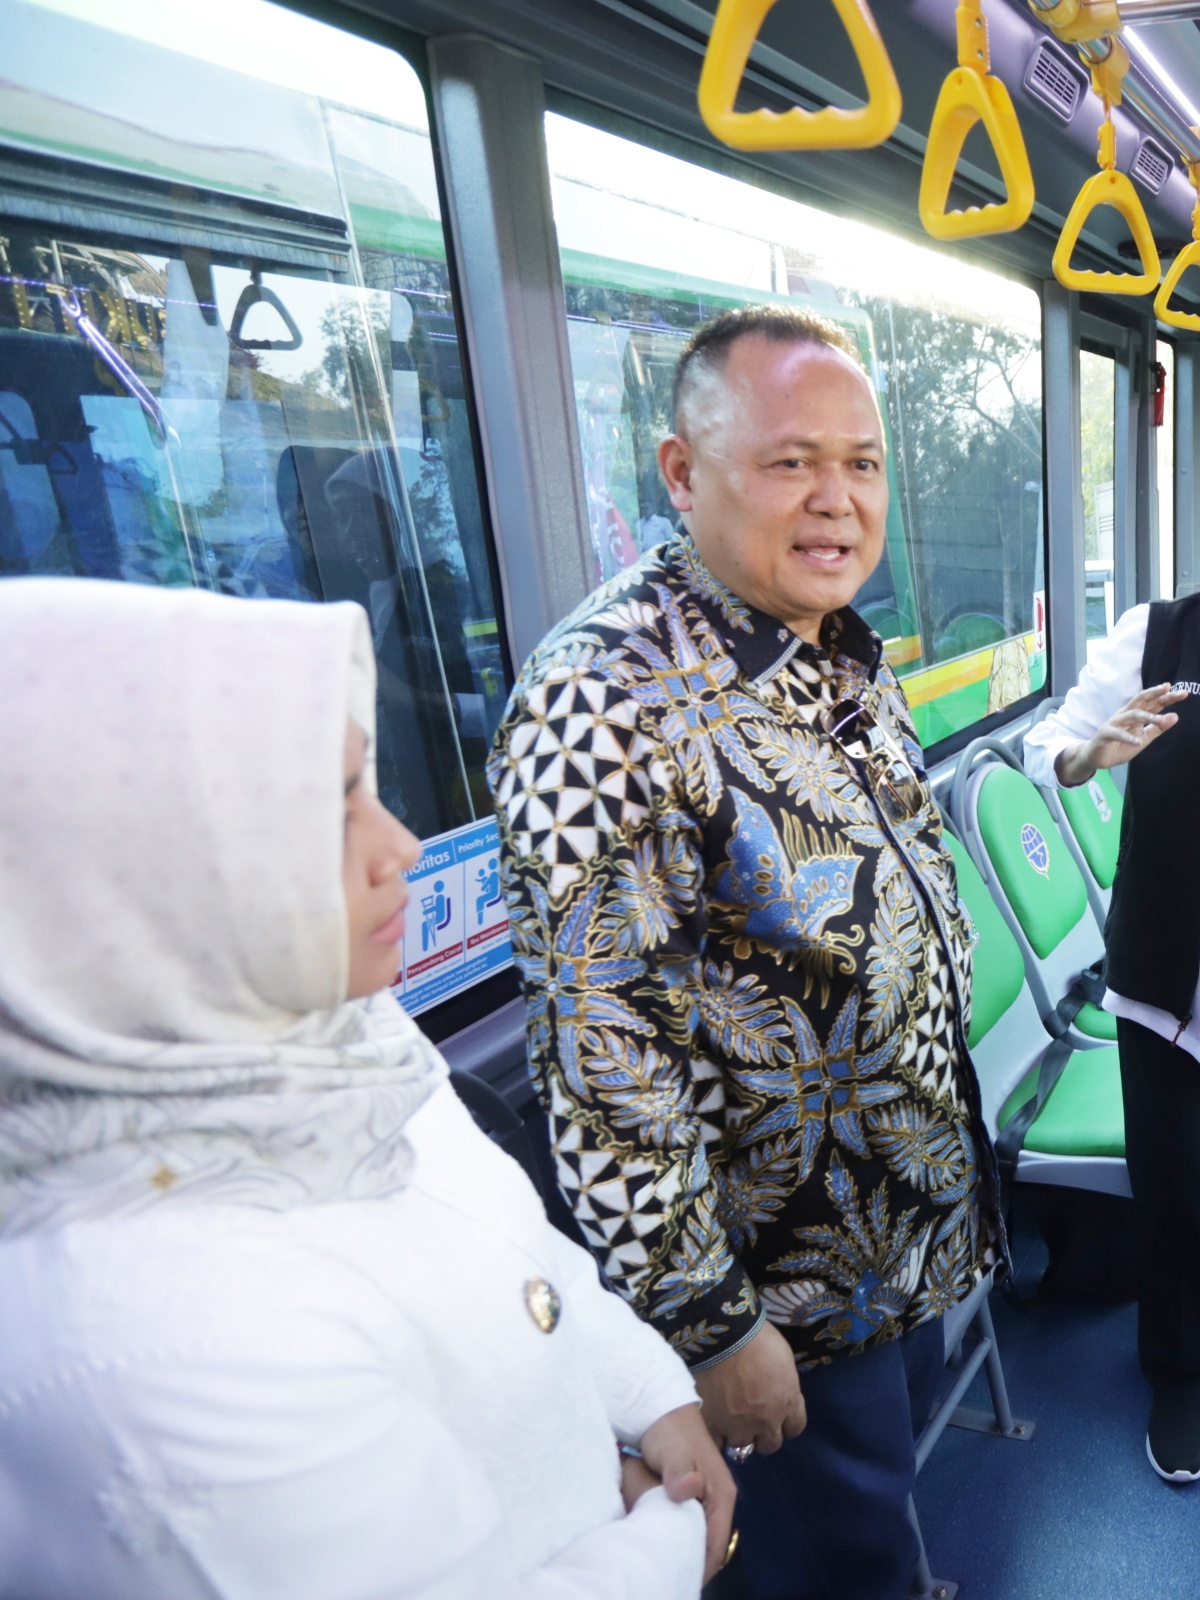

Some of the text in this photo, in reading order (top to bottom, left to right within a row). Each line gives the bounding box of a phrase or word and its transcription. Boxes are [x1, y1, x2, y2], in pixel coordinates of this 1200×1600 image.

[458, 839, 484, 853] Priority
[480, 924, 507, 940] Membawa
[408, 957, 443, 975] Penyandang
